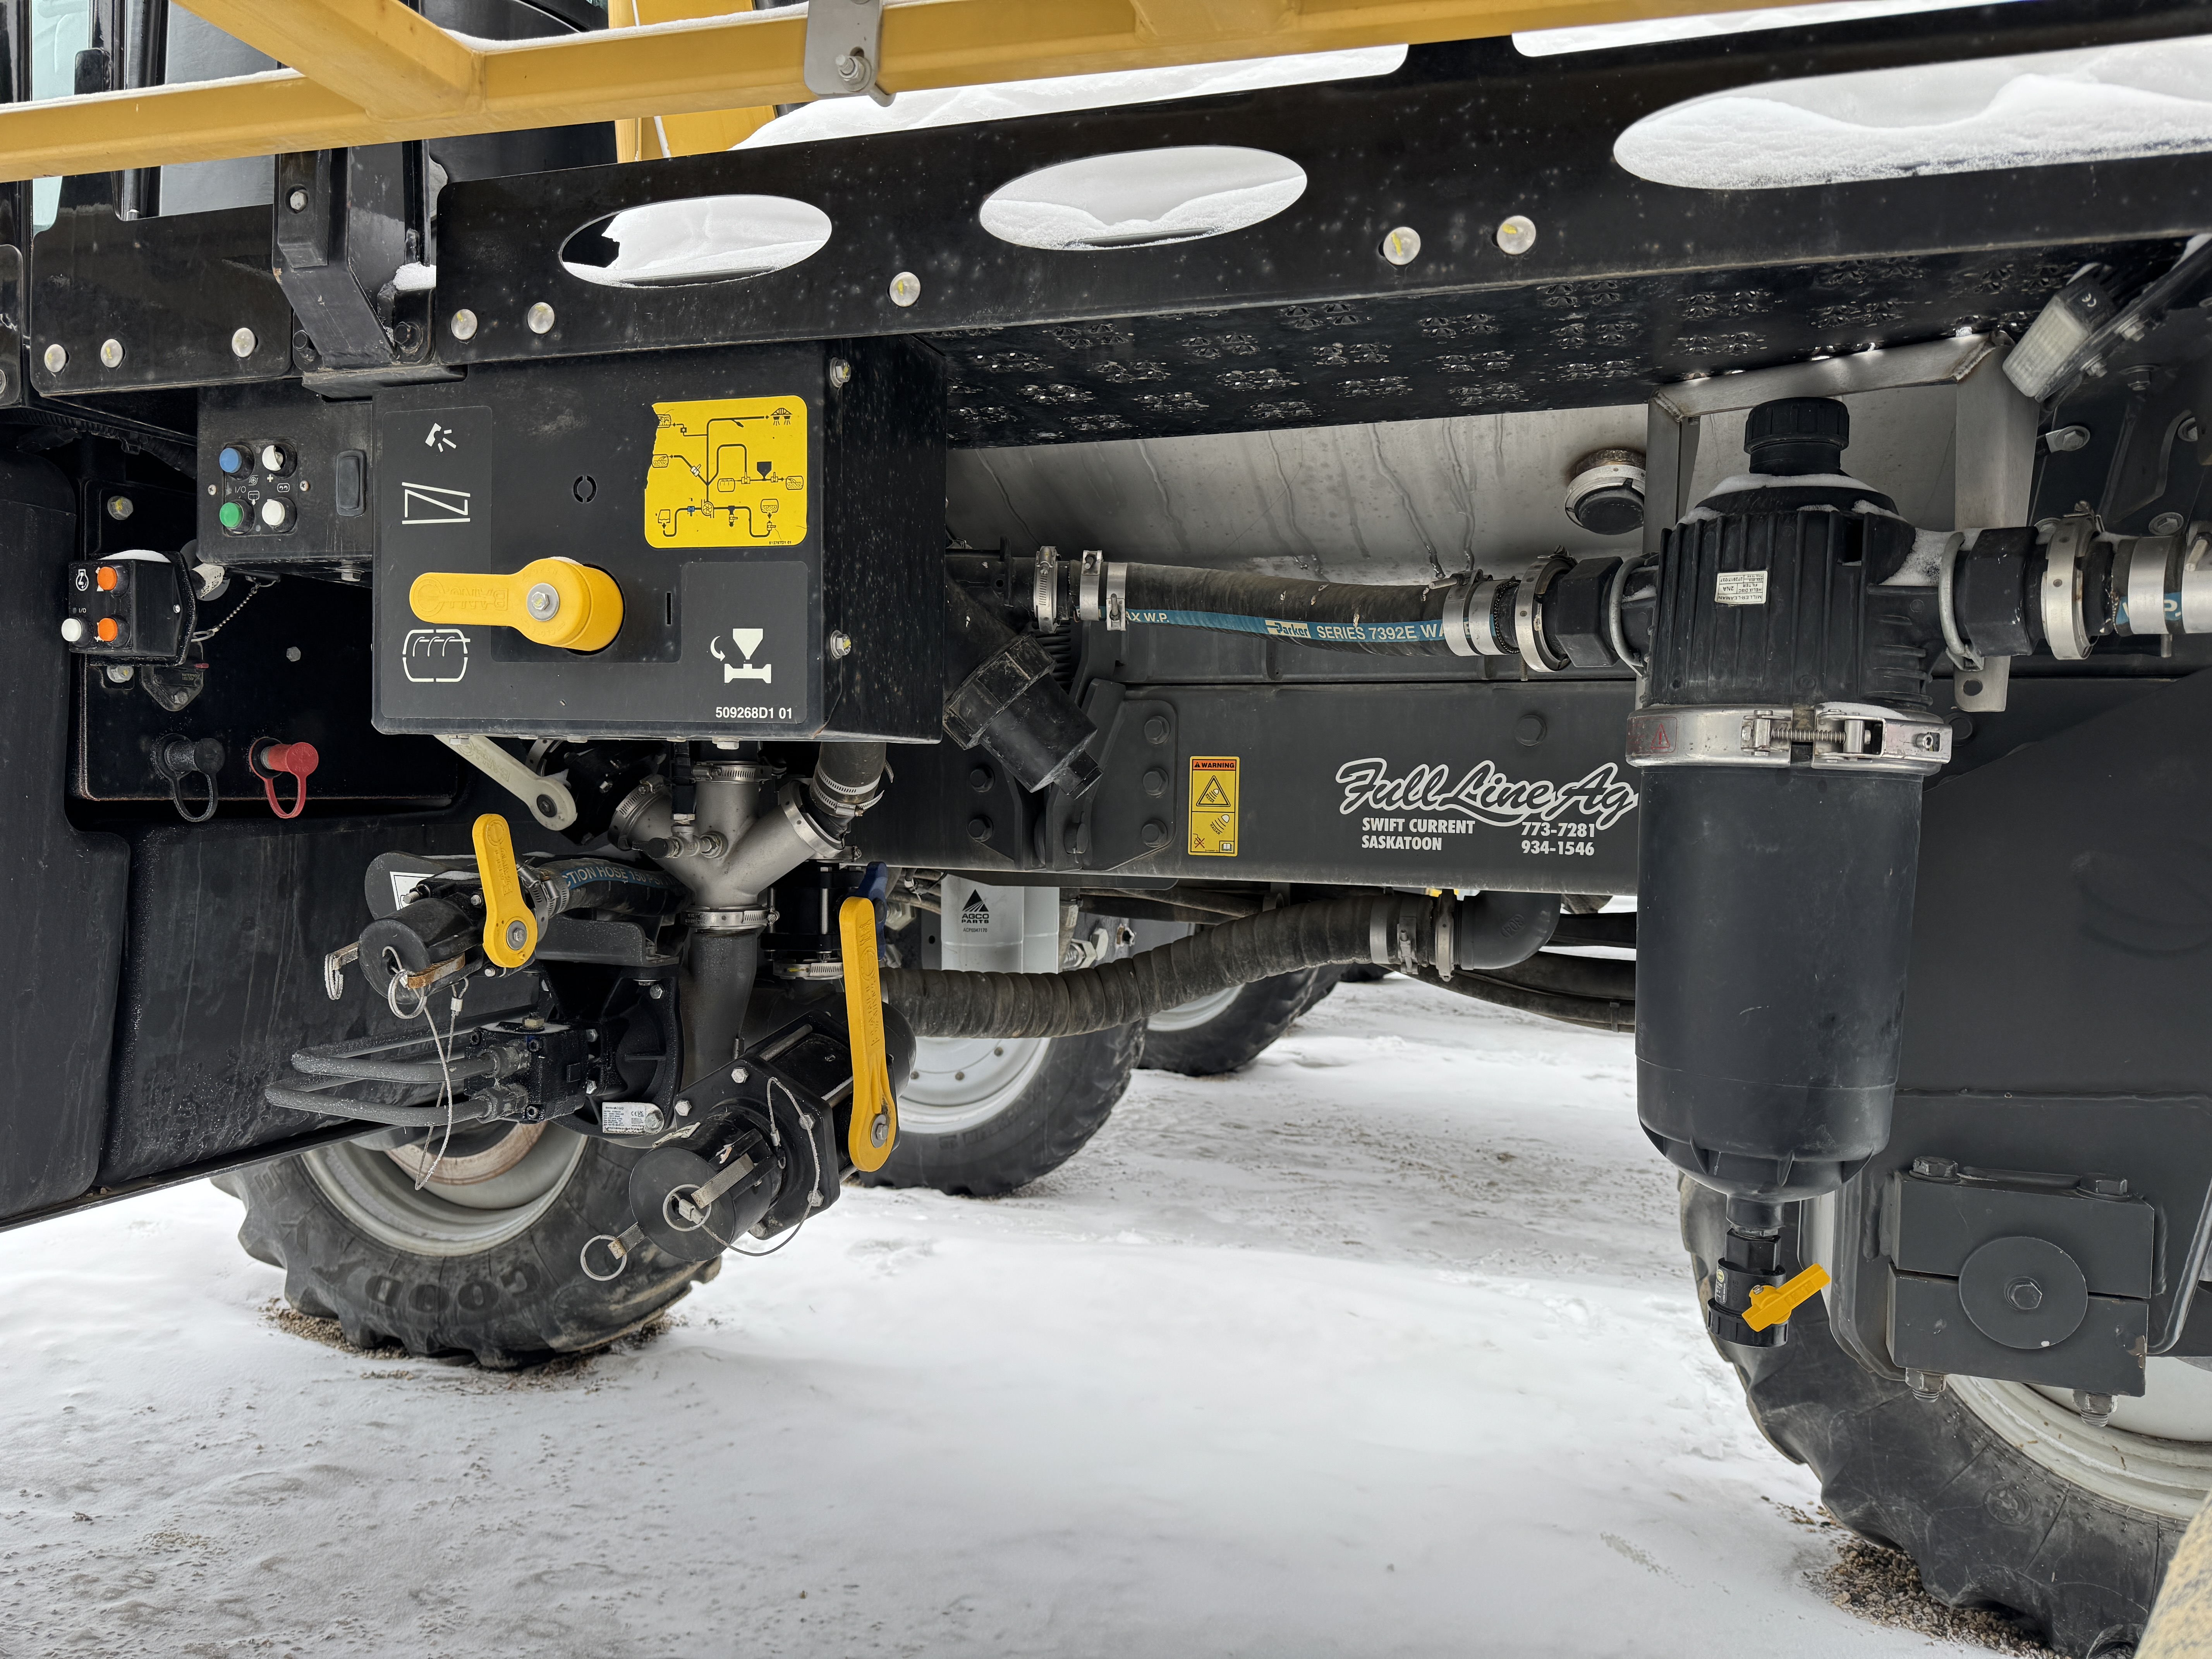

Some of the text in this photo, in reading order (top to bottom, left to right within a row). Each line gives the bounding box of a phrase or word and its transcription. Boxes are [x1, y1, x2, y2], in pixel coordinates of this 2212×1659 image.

[1144, 612, 1170, 622] W.P.
[1266, 620, 1311, 638] Parker
[1317, 626, 1366, 639] SERIES
[1368, 625, 1417, 640] 7392E
[716, 707, 792, 719] 509268D1 01
[1335, 758, 1638, 830] Full Line Ag
[1209, 824, 1220, 835] RADAR
[1362, 817, 1475, 834] SWIFT CURRENT
[1522, 822, 1595, 838] 773-7281
[1362, 835, 1442, 850] SASKATOON
[1522, 840, 1595, 856] 934-1546
[596, 867, 628, 879] HOSE
[629, 871, 646, 882] 150
